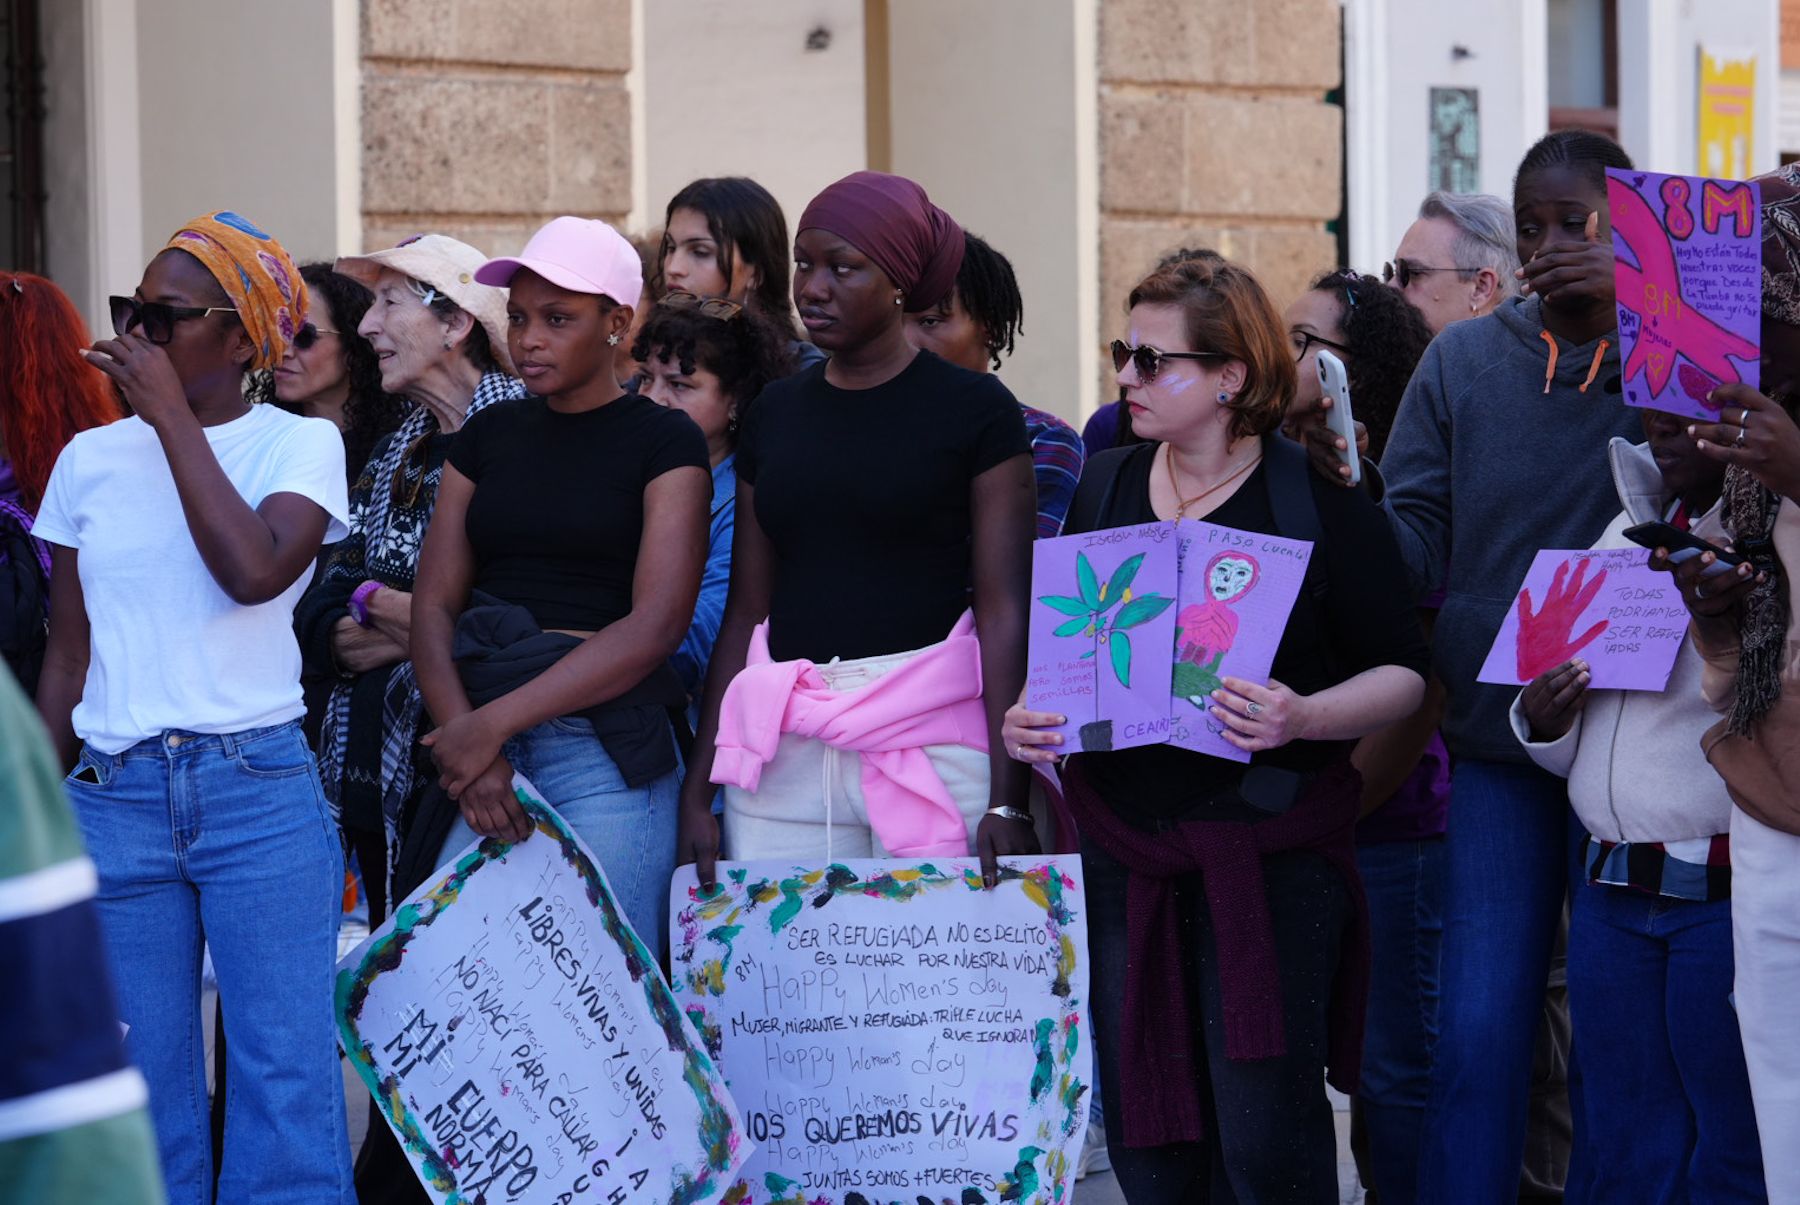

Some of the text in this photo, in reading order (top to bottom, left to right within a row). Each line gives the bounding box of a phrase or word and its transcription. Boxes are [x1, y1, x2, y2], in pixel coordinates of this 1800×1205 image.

[1659, 175, 1755, 241] 8M
[1208, 529, 1254, 547] PASO
[1604, 626, 1642, 640] SER
[947, 922, 969, 944] NO
[974, 926, 992, 944] ES
[734, 952, 757, 982] 8M
[814, 951, 838, 966] ES
[845, 952, 905, 968] LUCHAR
[919, 953, 950, 968] POR
[954, 949, 1009, 970] NUESTRA
[849, 1014, 858, 1028] Y
[977, 1008, 1023, 1022] LUCHA
[942, 1027, 974, 1042] QUE
[449, 955, 479, 990] NO
[511, 1041, 550, 1100] PARA
[549, 1096, 598, 1163] CALLAR
[805, 1110, 921, 1144] QUEREMOS
[803, 1168, 862, 1190] JUNTAS
[866, 1170, 910, 1188] SOMOS
